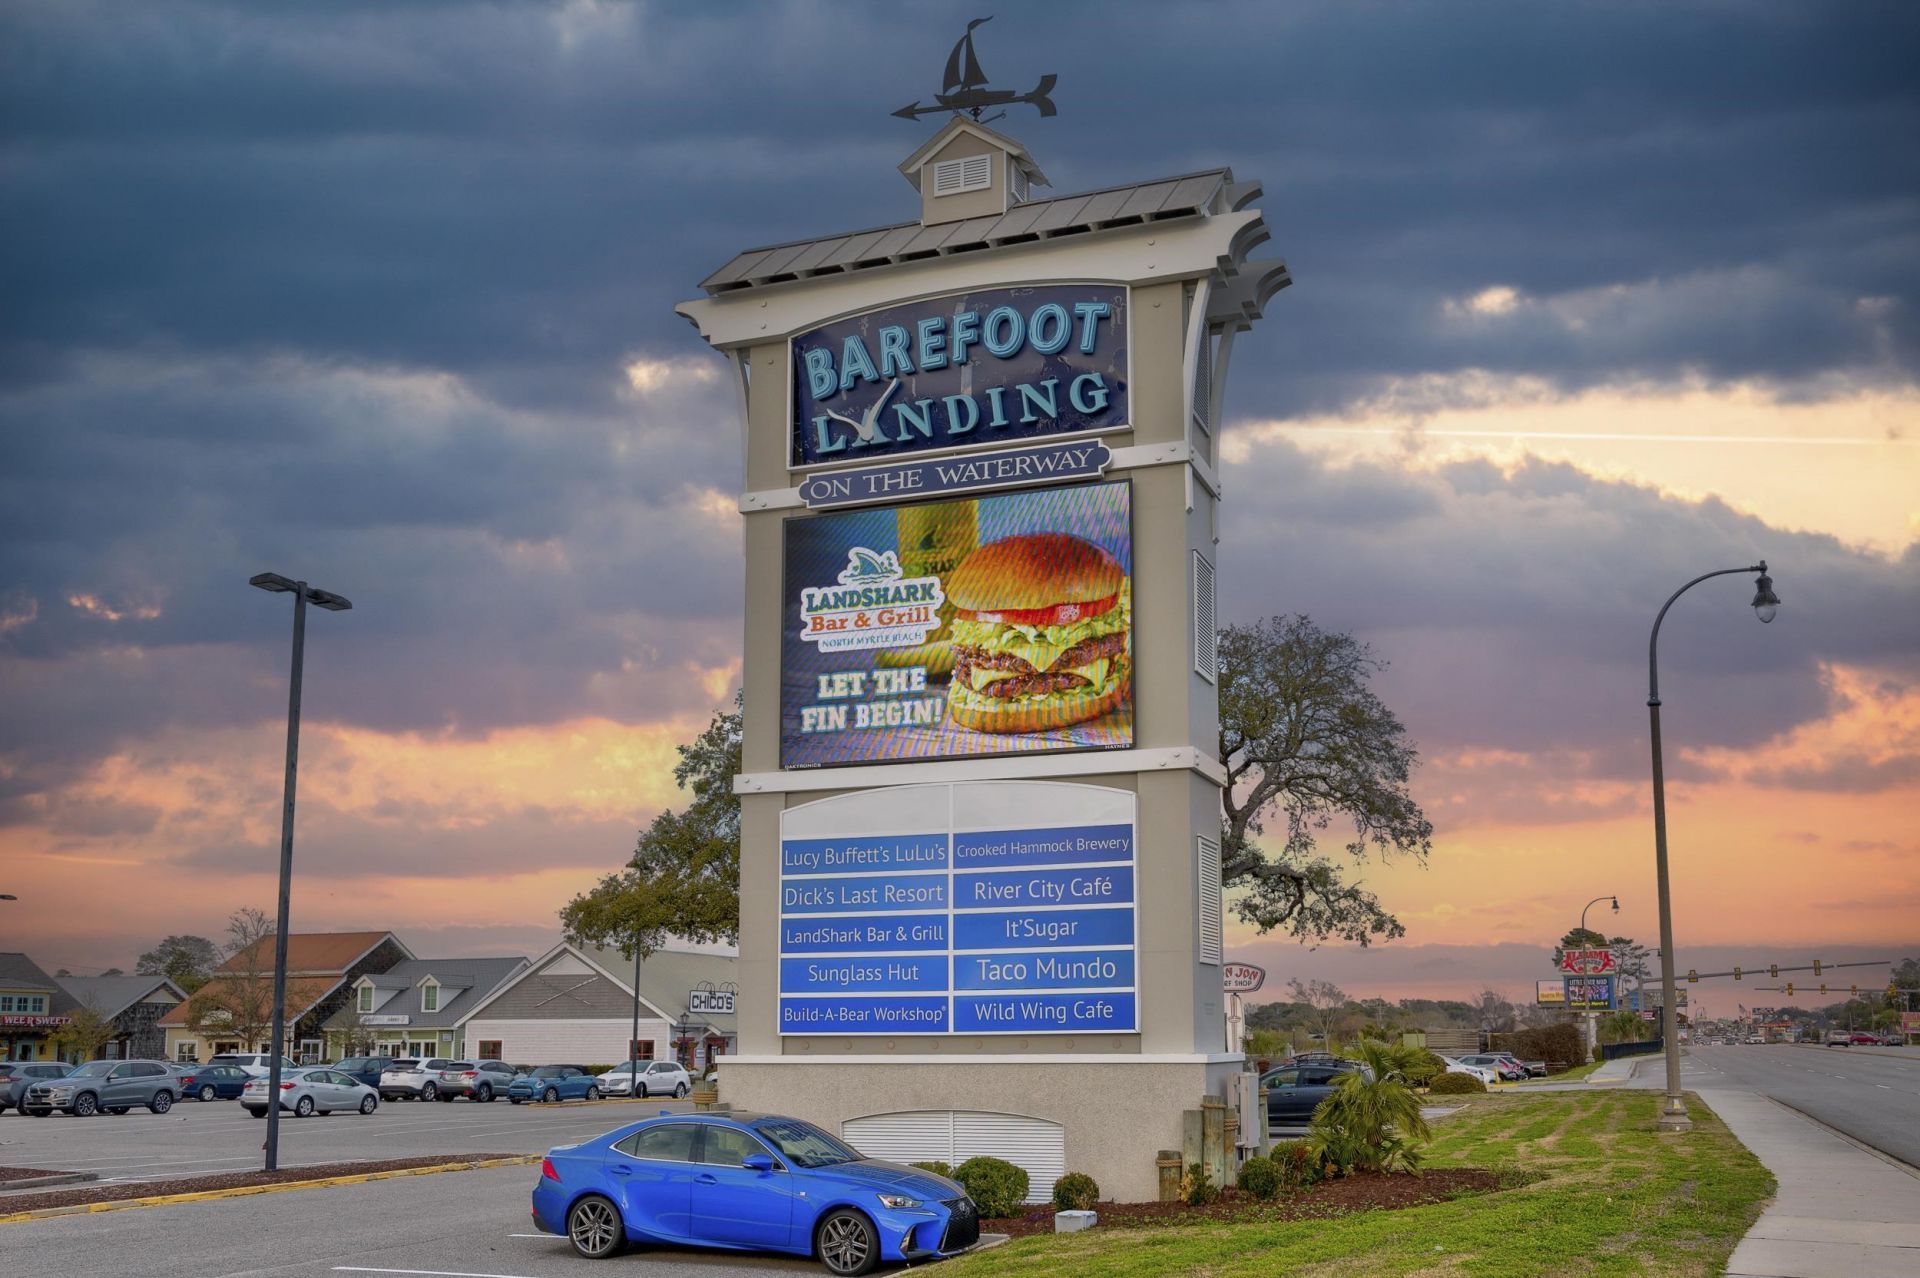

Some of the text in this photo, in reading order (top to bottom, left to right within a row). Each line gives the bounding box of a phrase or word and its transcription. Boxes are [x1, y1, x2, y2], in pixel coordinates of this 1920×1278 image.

[804, 302, 1112, 401] BAREFOOT
[811, 372, 1110, 454] LANDING
[810, 448, 1094, 500] ON THE WATERWAY
[805, 582, 936, 613] LANDSHARK
[810, 606, 931, 633] Bar & Grill
[822, 632, 922, 648] NORTH MYRTLE BEACH
[818, 667, 926, 698] LET THE
[802, 699, 942, 732] FIN BEGIN!
[785, 844, 945, 869] Lucy Buffett's LuLu's
[957, 837, 1129, 857] Crooked Hammock Brewery
[785, 884, 943, 906] Dick's Last Resort
[975, 876, 1112, 902] River City Café
[786, 925, 944, 944] LandShark Bar & Grill
[1006, 919, 1078, 941] It'Sugar
[808, 964, 919, 986] Sunglass Hut
[976, 957, 1116, 981] Taco Mundo
[1236, 968, 1258, 980] JON
[692, 994, 733, 1010] CHICO'S
[975, 1001, 1114, 1024] Wild Wing Cafe
[4, 1016, 25, 1025] WEE
[26, 1016, 34, 1027] R
[784, 1007, 870, 1022] Build-A-Bear
